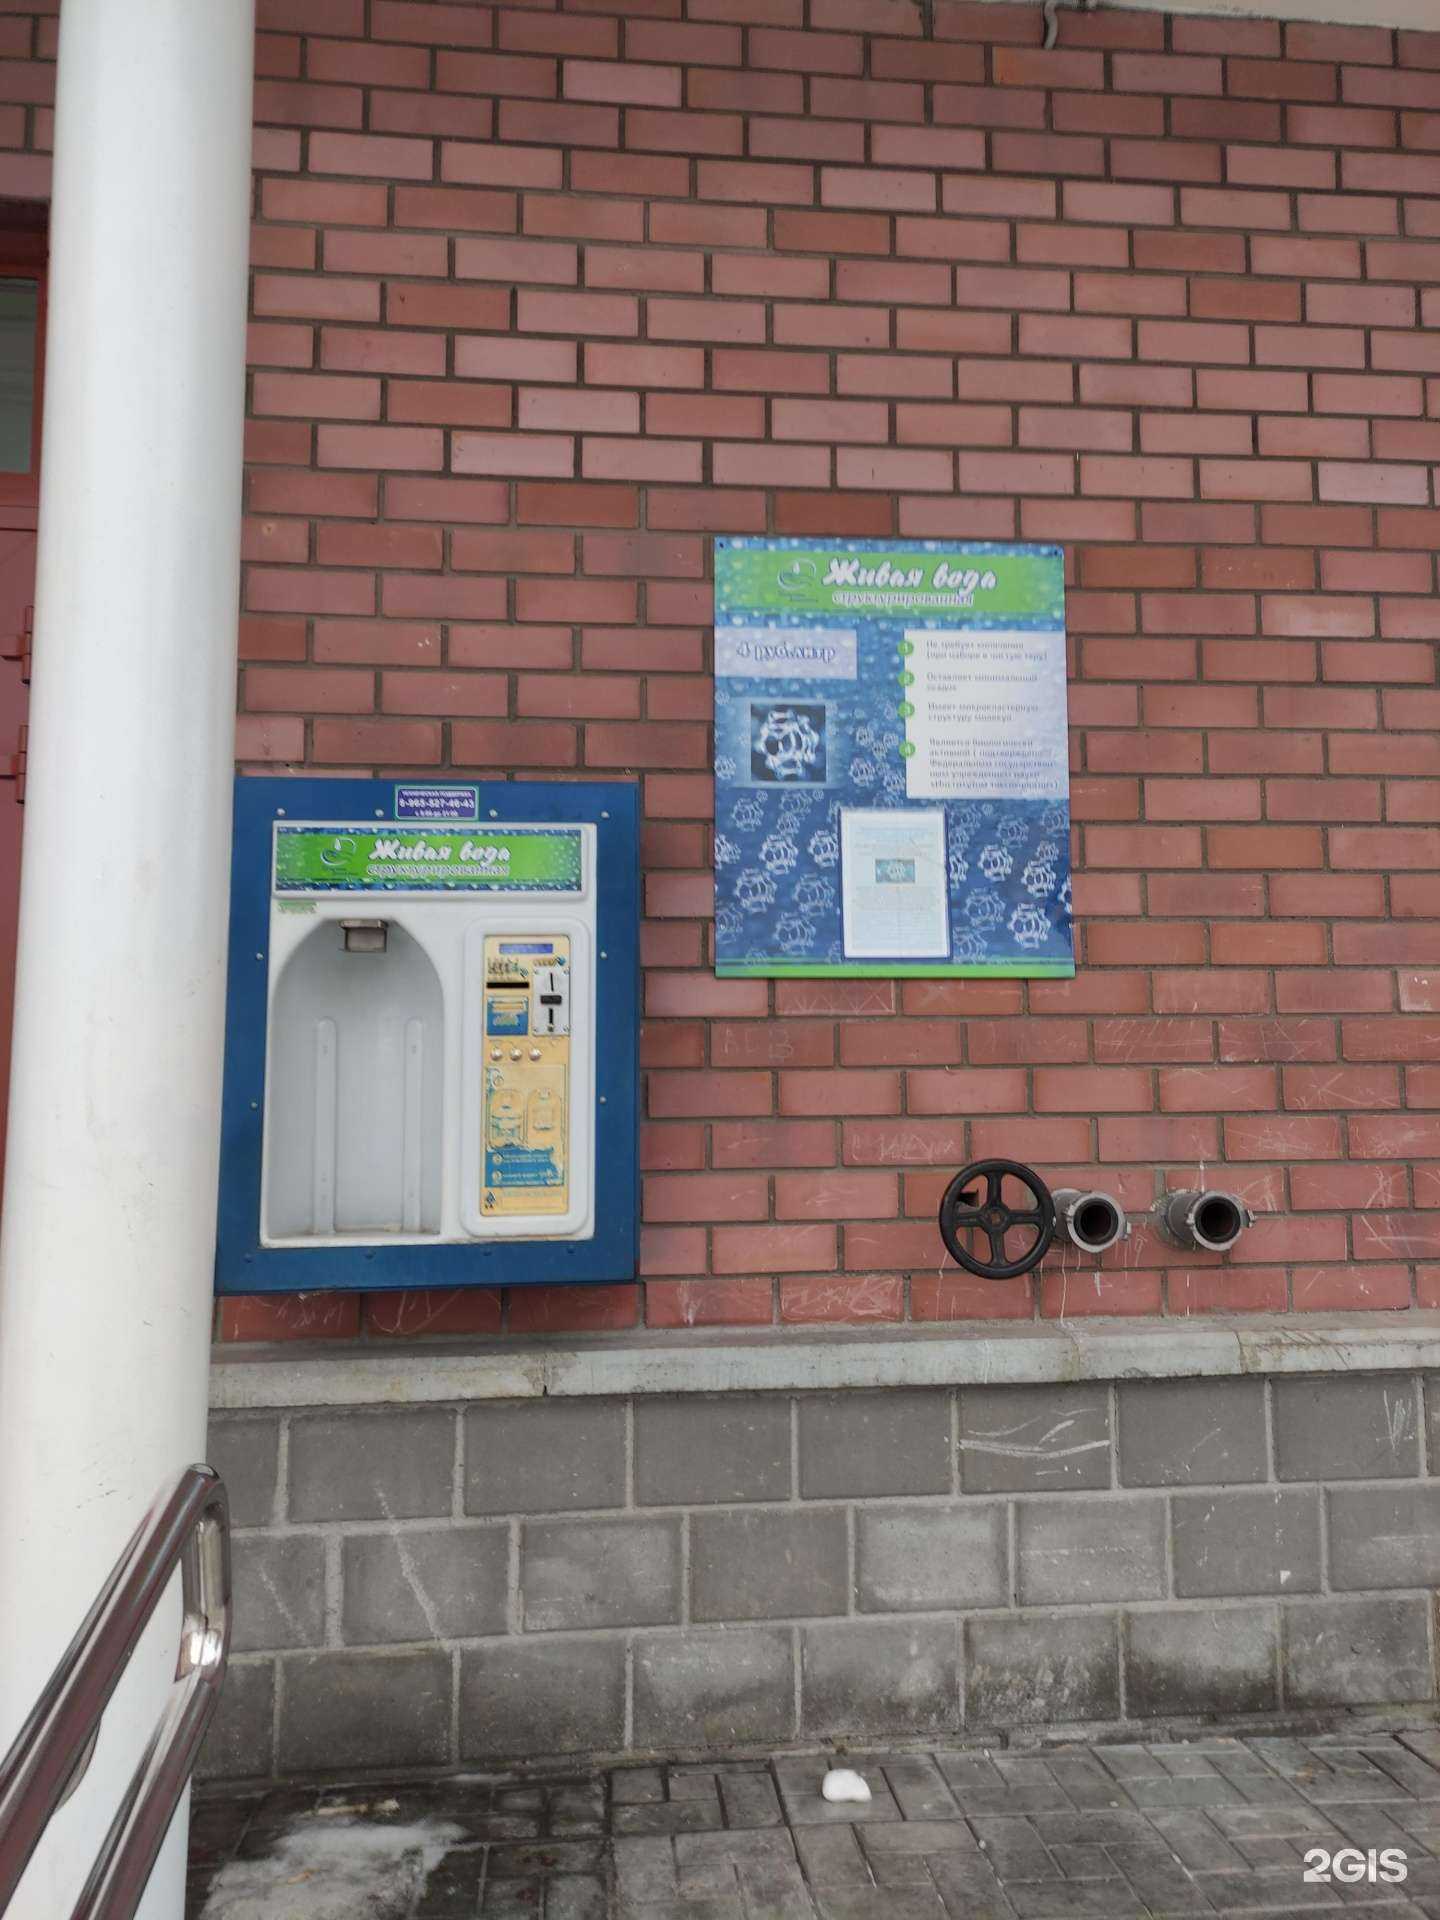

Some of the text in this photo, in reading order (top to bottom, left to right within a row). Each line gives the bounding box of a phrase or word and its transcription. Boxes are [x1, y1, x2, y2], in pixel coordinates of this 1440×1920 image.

[821, 557, 997, 598] Живая вода
[368, 838, 511, 868] Живая вода
